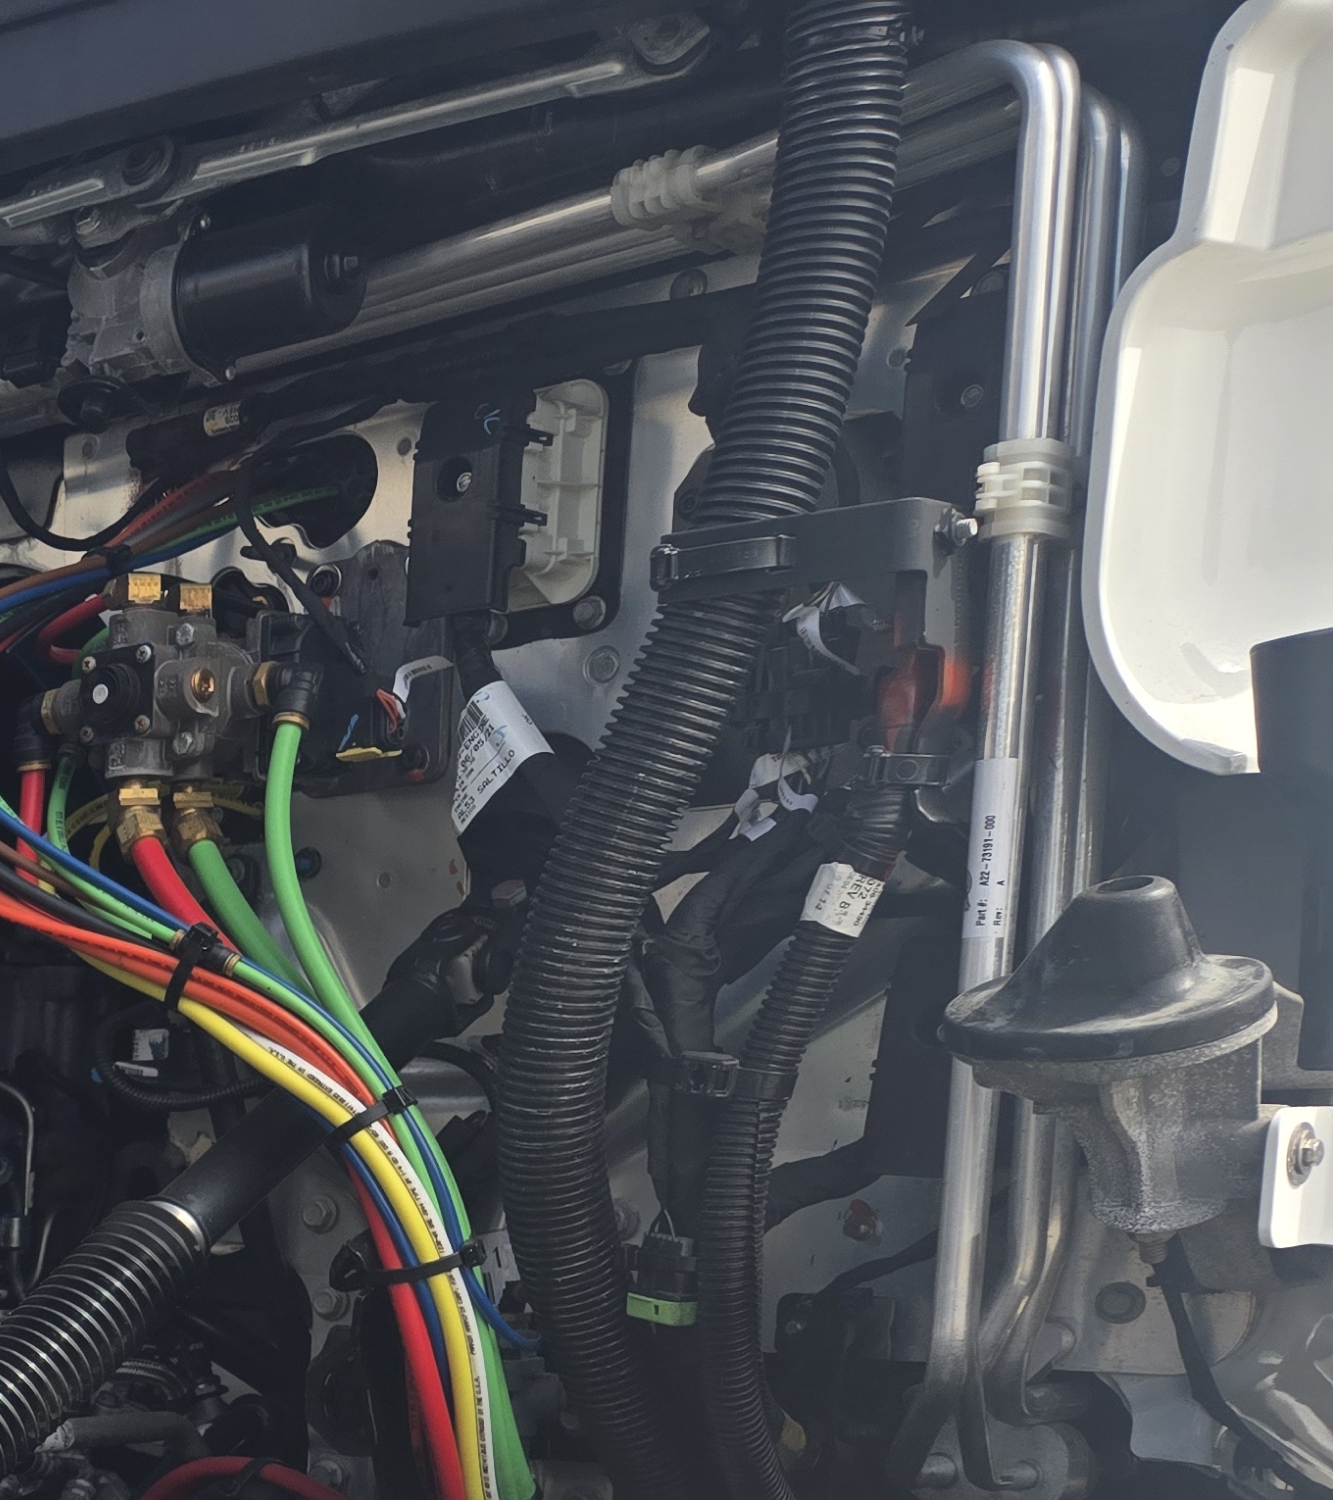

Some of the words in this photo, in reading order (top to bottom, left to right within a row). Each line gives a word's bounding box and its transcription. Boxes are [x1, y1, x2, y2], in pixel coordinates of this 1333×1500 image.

[476, 748, 516, 795] SALTILLO
[975, 909, 988, 926] Part
[992, 907, 1004, 926] Rev:
[287, 1058, 297, 1069] THE
